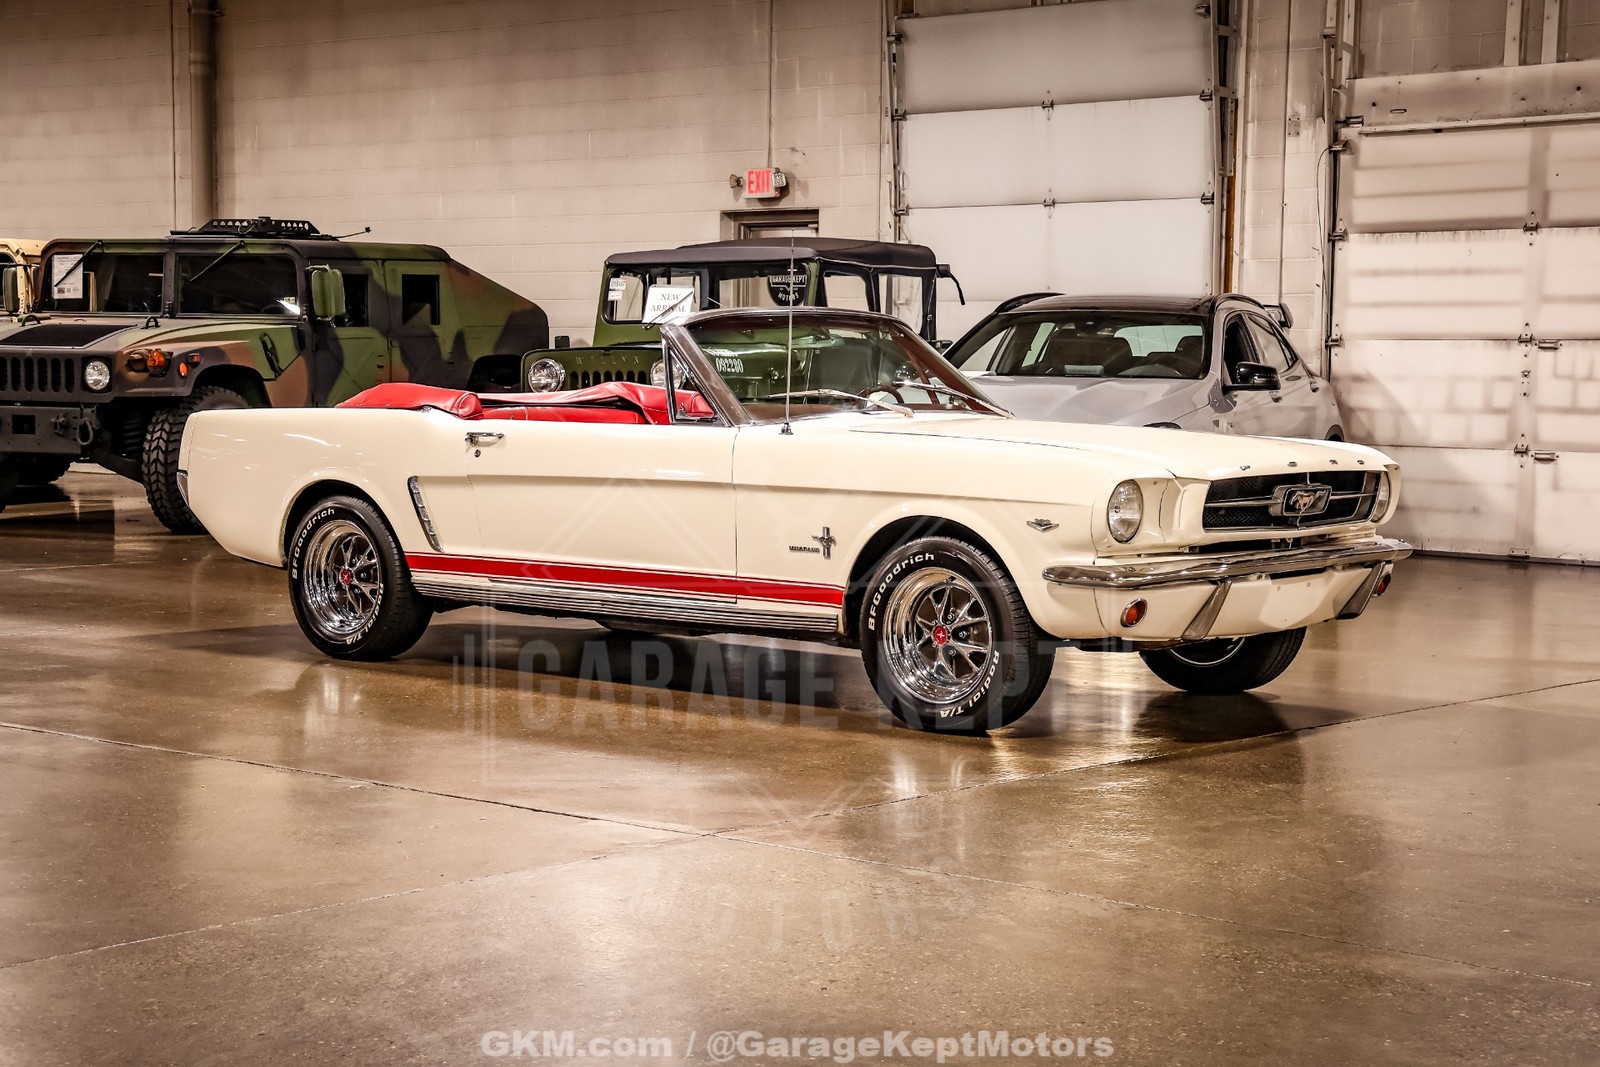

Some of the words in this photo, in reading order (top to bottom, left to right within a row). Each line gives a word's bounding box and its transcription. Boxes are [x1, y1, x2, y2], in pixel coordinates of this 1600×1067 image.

[747, 169, 772, 194] EXIT
[660, 293, 681, 301] NEW
[291, 507, 336, 580] BFGoodrich
[867, 551, 935, 631] BFGoodrich
[968, 649, 1000, 708] Radial
[939, 708, 965, 719] T/A
